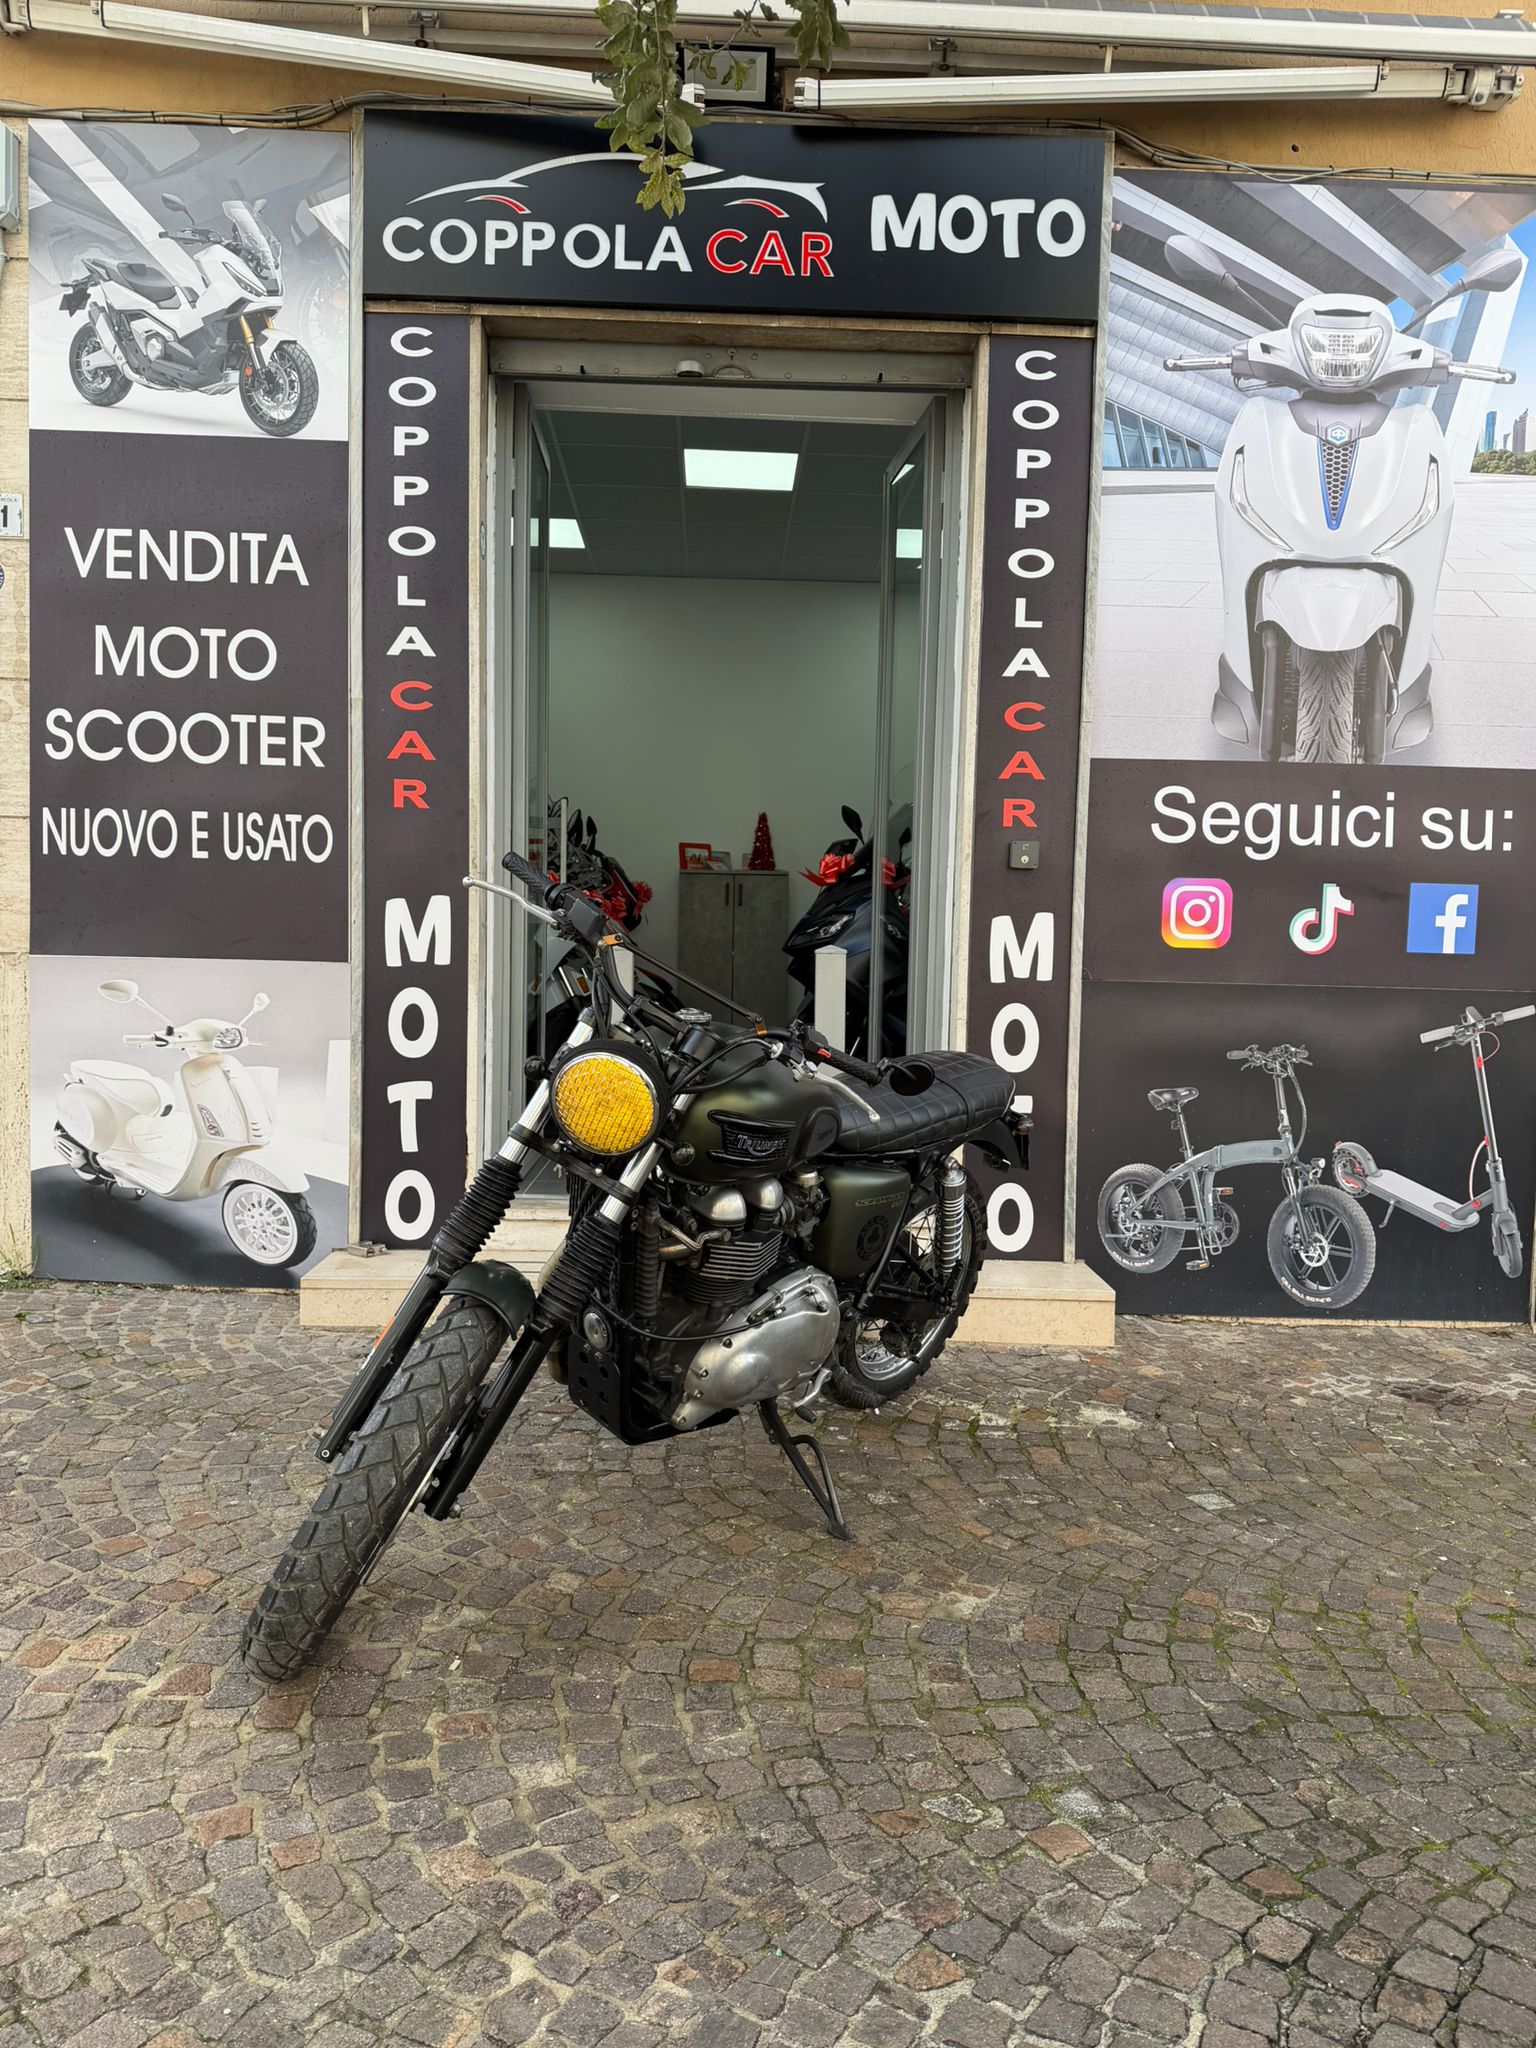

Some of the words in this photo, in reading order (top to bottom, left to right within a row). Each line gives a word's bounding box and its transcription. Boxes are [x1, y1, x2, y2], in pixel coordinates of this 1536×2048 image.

[383, 217, 692, 271] COPPOLA
[706, 229, 835, 278] CAR
[871, 193, 1086, 258] MOTO
[64, 527, 309, 585] VENDITA
[95, 625, 278, 682] MOTO
[45, 707, 326, 767] SCOOTER
[42, 806, 177, 859] NUOVO
[191, 811, 208, 859] E
[223, 811, 334, 864] USATO
[1150, 785, 1395, 861] Seguici
[1420, 806, 1514, 852] su:
[384, 894, 452, 1241] MOTO
[987, 911, 1055, 1253] MOO
